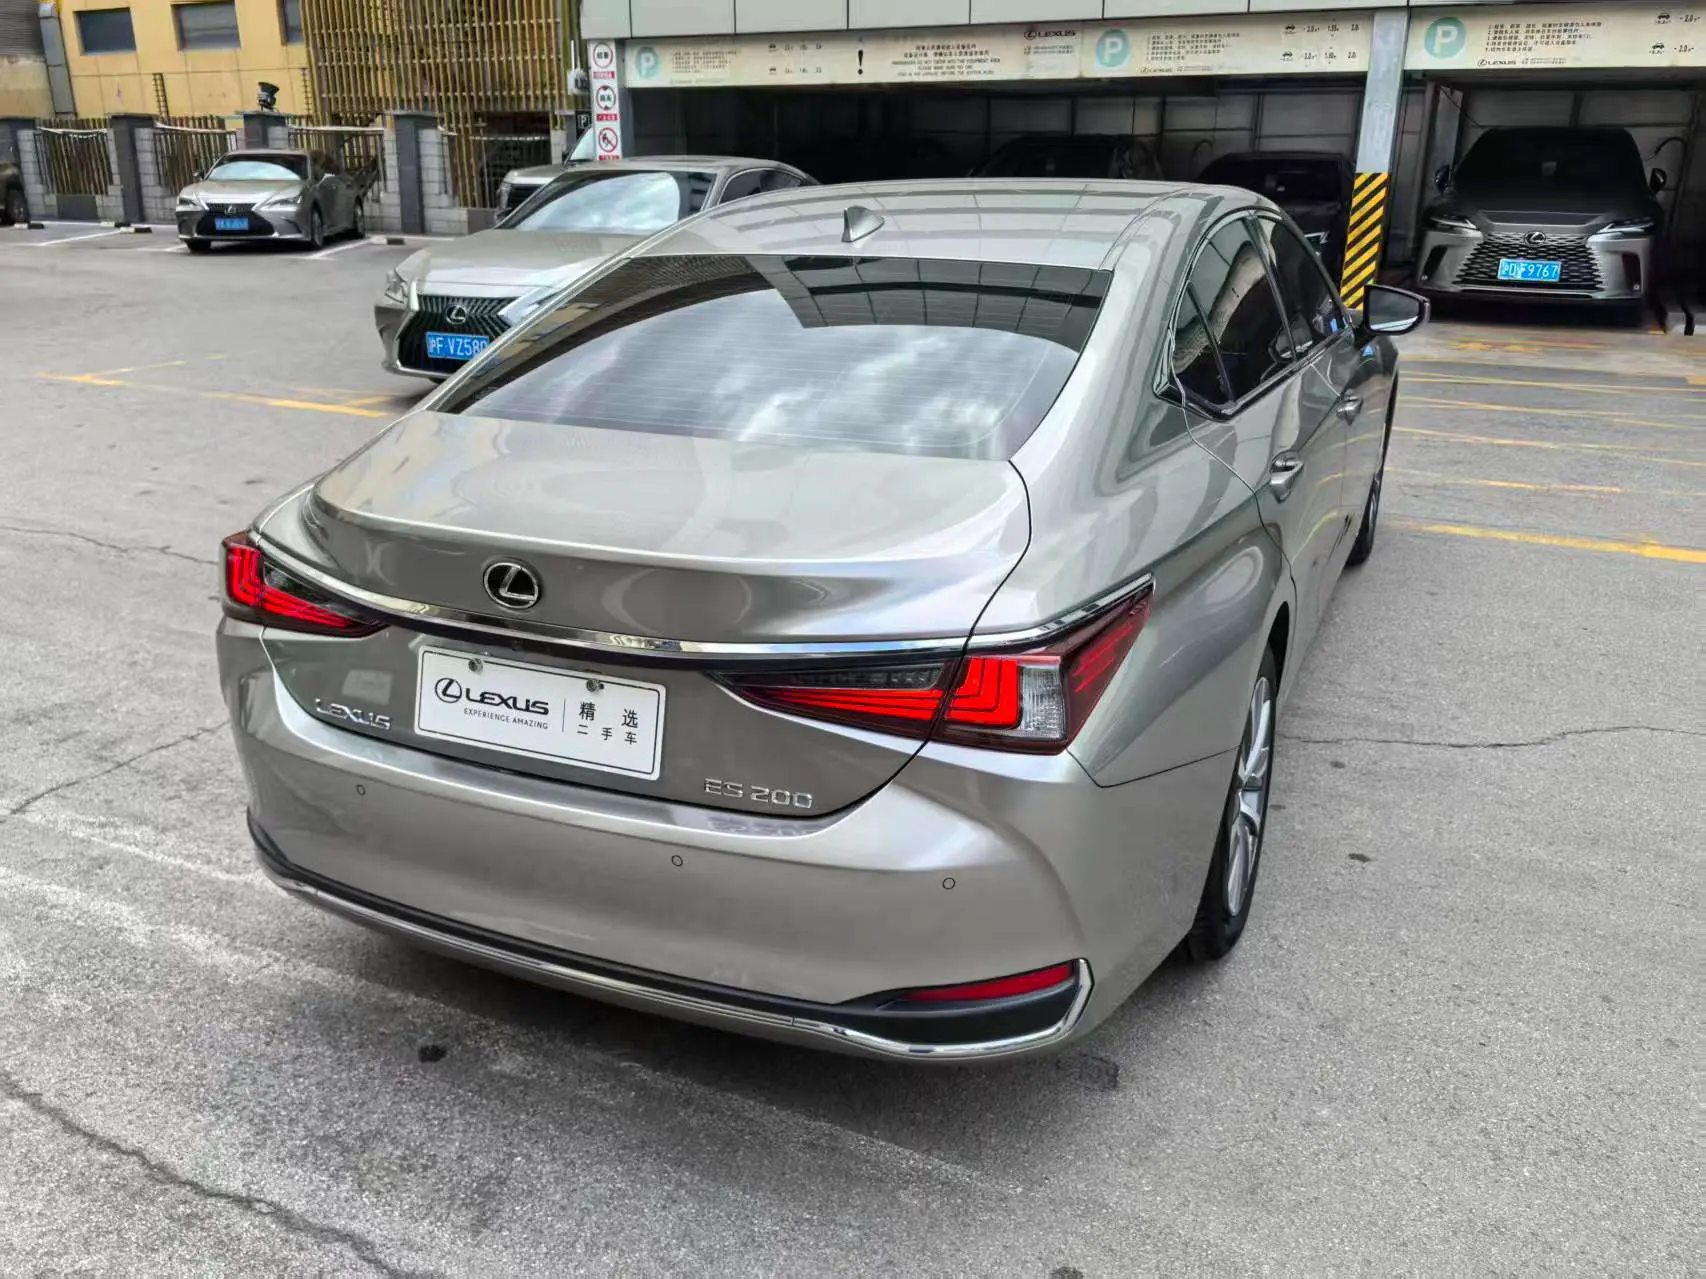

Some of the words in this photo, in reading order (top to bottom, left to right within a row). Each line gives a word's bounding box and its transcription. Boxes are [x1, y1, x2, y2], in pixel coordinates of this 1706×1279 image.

[1103, 35, 1124, 64] P
[1433, 25, 1459, 55] P
[315, 698, 391, 730] LEXUS
[465, 687, 549, 715] LEXUS
[463, 707, 510, 723] EXPERIENCE
[512, 717, 549, 730] AMAZING
[704, 778, 744, 798] ES
[750, 785, 813, 809] 200
